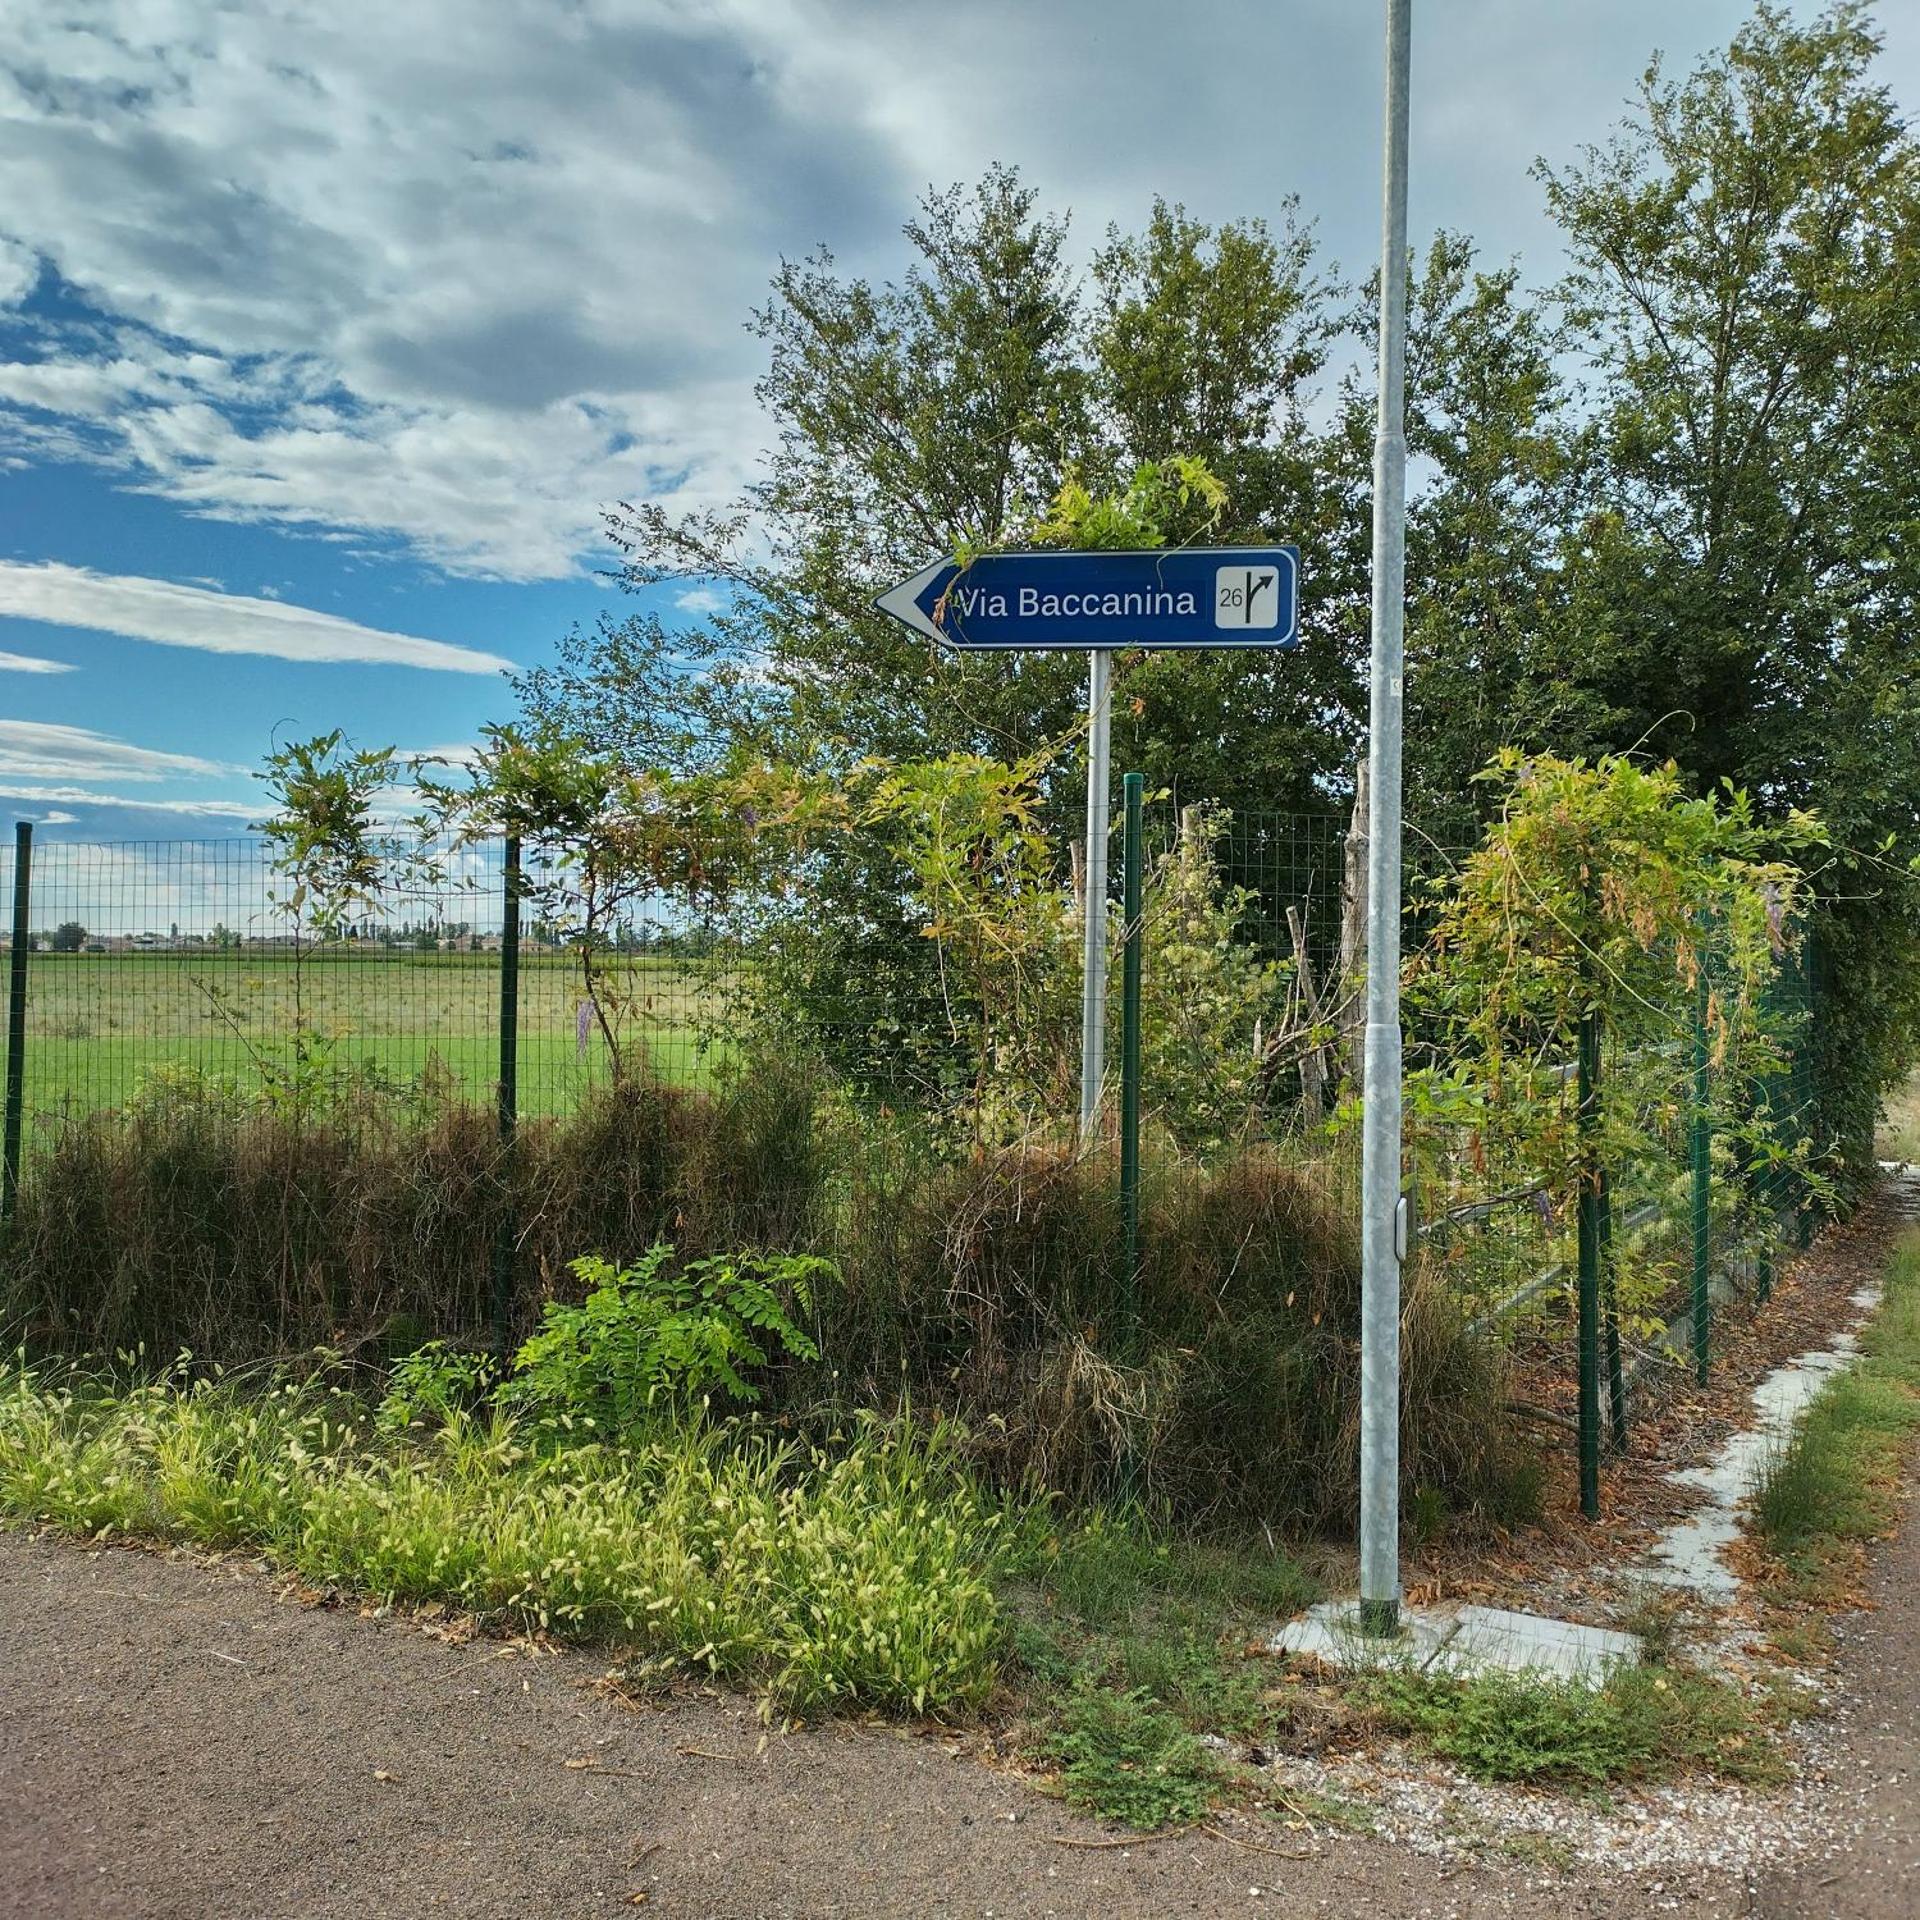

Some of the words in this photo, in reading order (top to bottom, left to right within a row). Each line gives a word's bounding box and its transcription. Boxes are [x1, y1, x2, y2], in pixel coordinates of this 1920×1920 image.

[957, 587, 1008, 617] Via
[1018, 585, 1197, 617] Baccanina
[1219, 588, 1243, 608] 26
